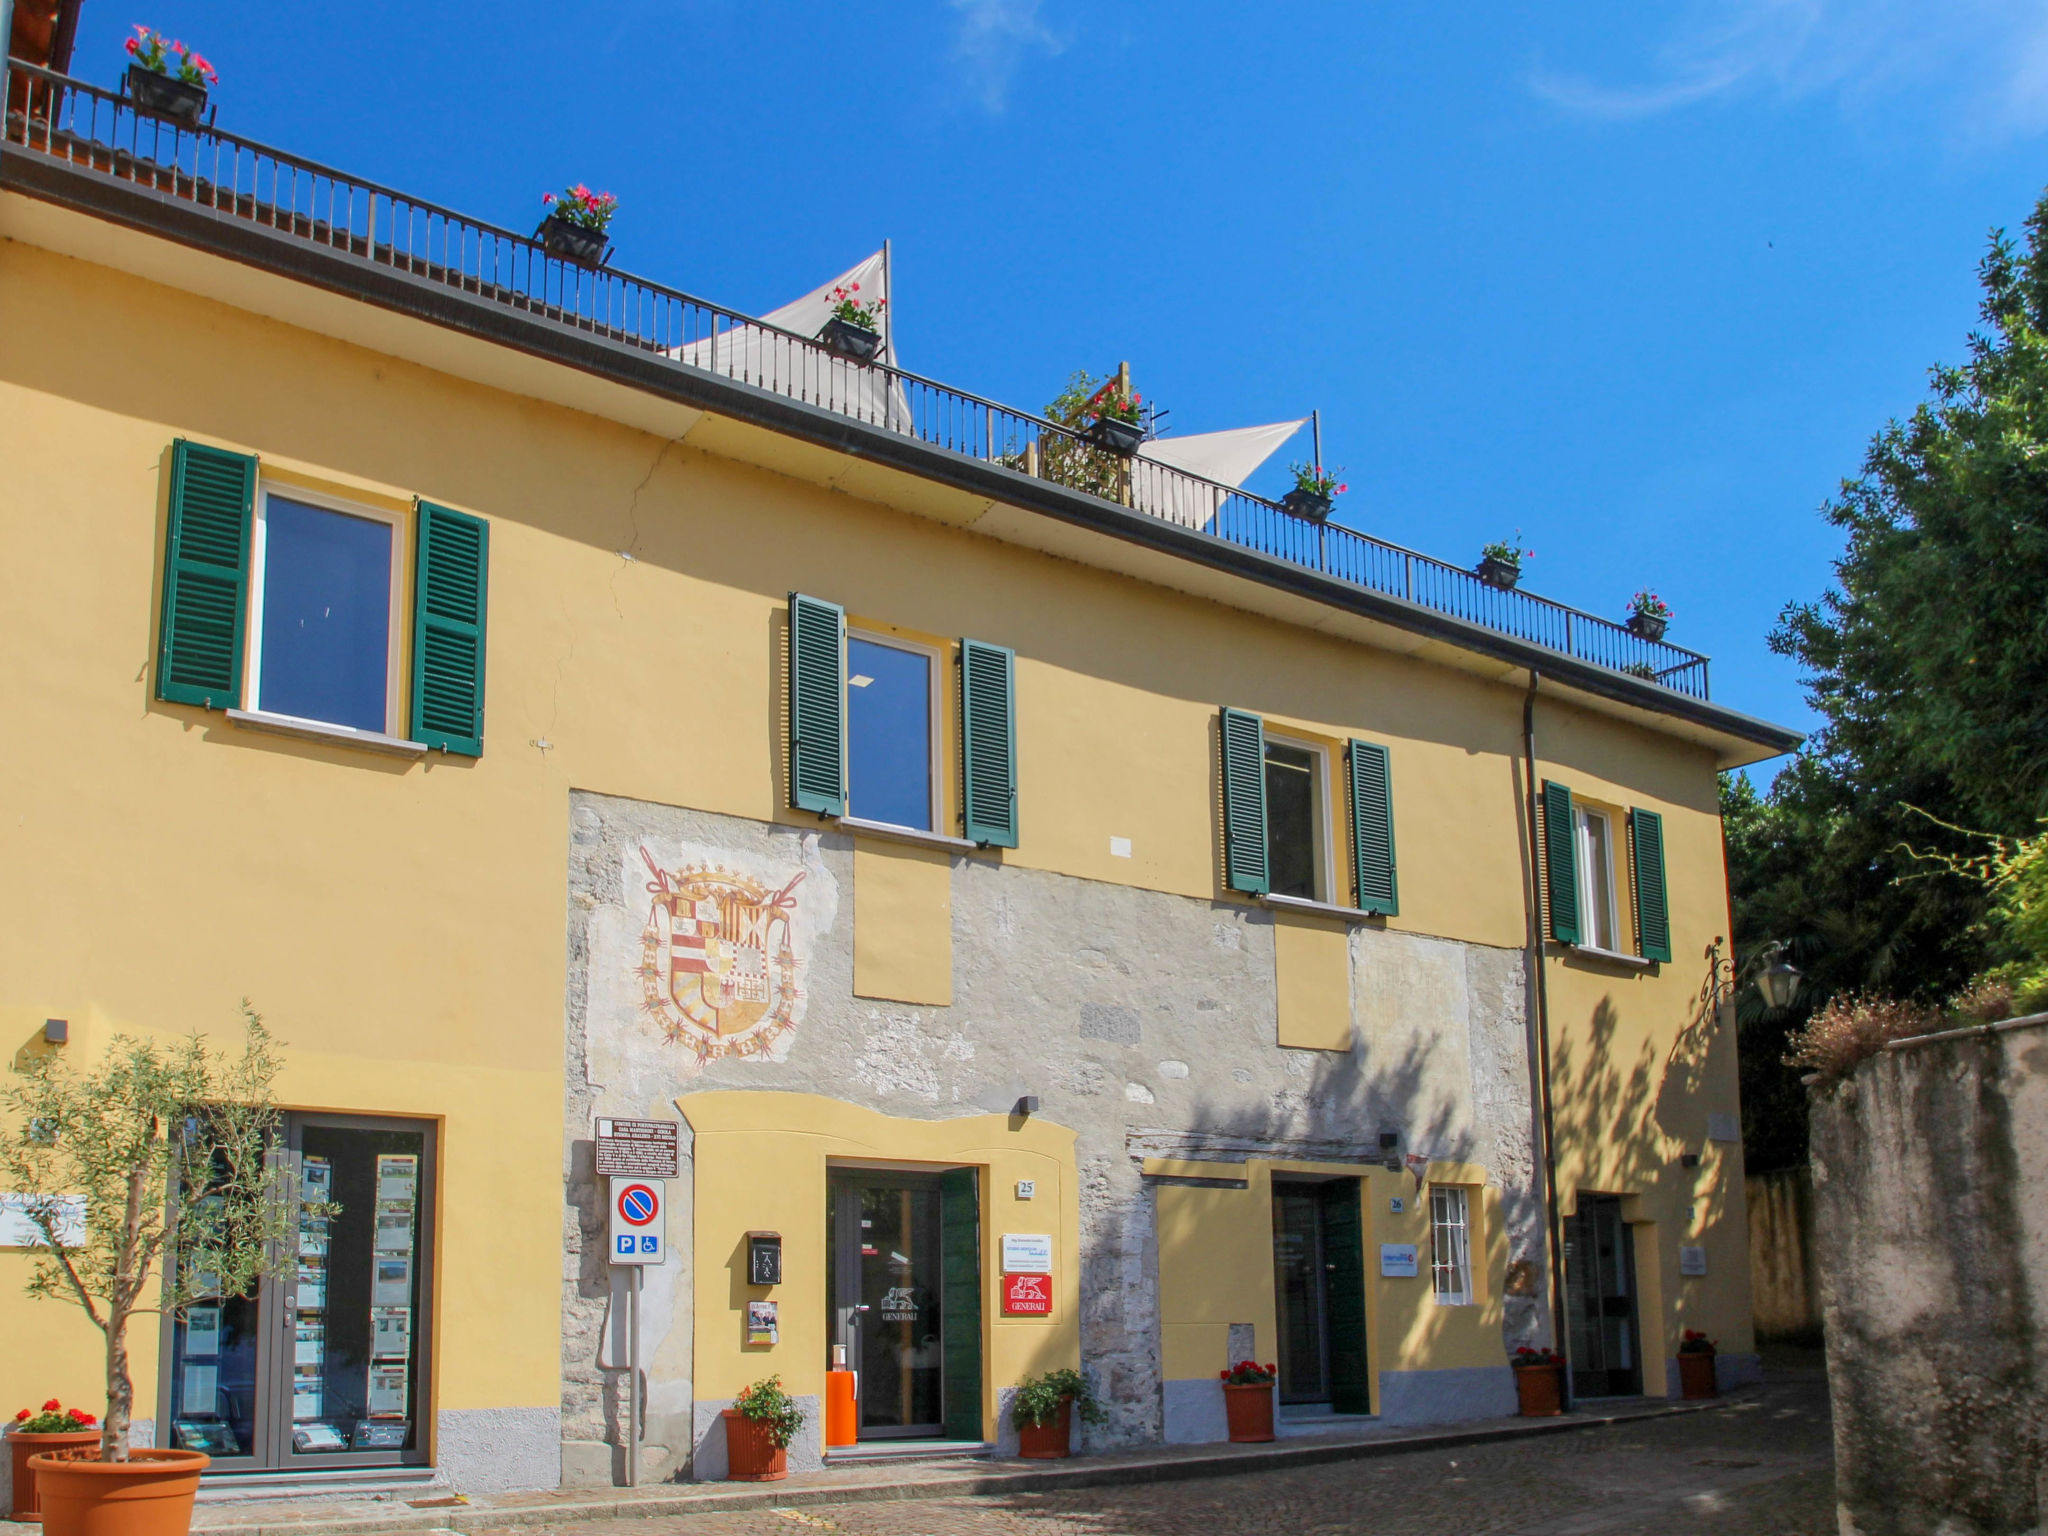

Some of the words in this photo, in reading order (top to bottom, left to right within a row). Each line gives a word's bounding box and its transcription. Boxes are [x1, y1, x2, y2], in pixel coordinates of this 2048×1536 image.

[1021, 1182, 1033, 1193] 25
[1392, 1199, 1402, 1209] 26
[621, 1238, 632, 1252] P
[1011, 1302, 1045, 1311] GENERALI
[882, 1312, 917, 1321] GENERALI
